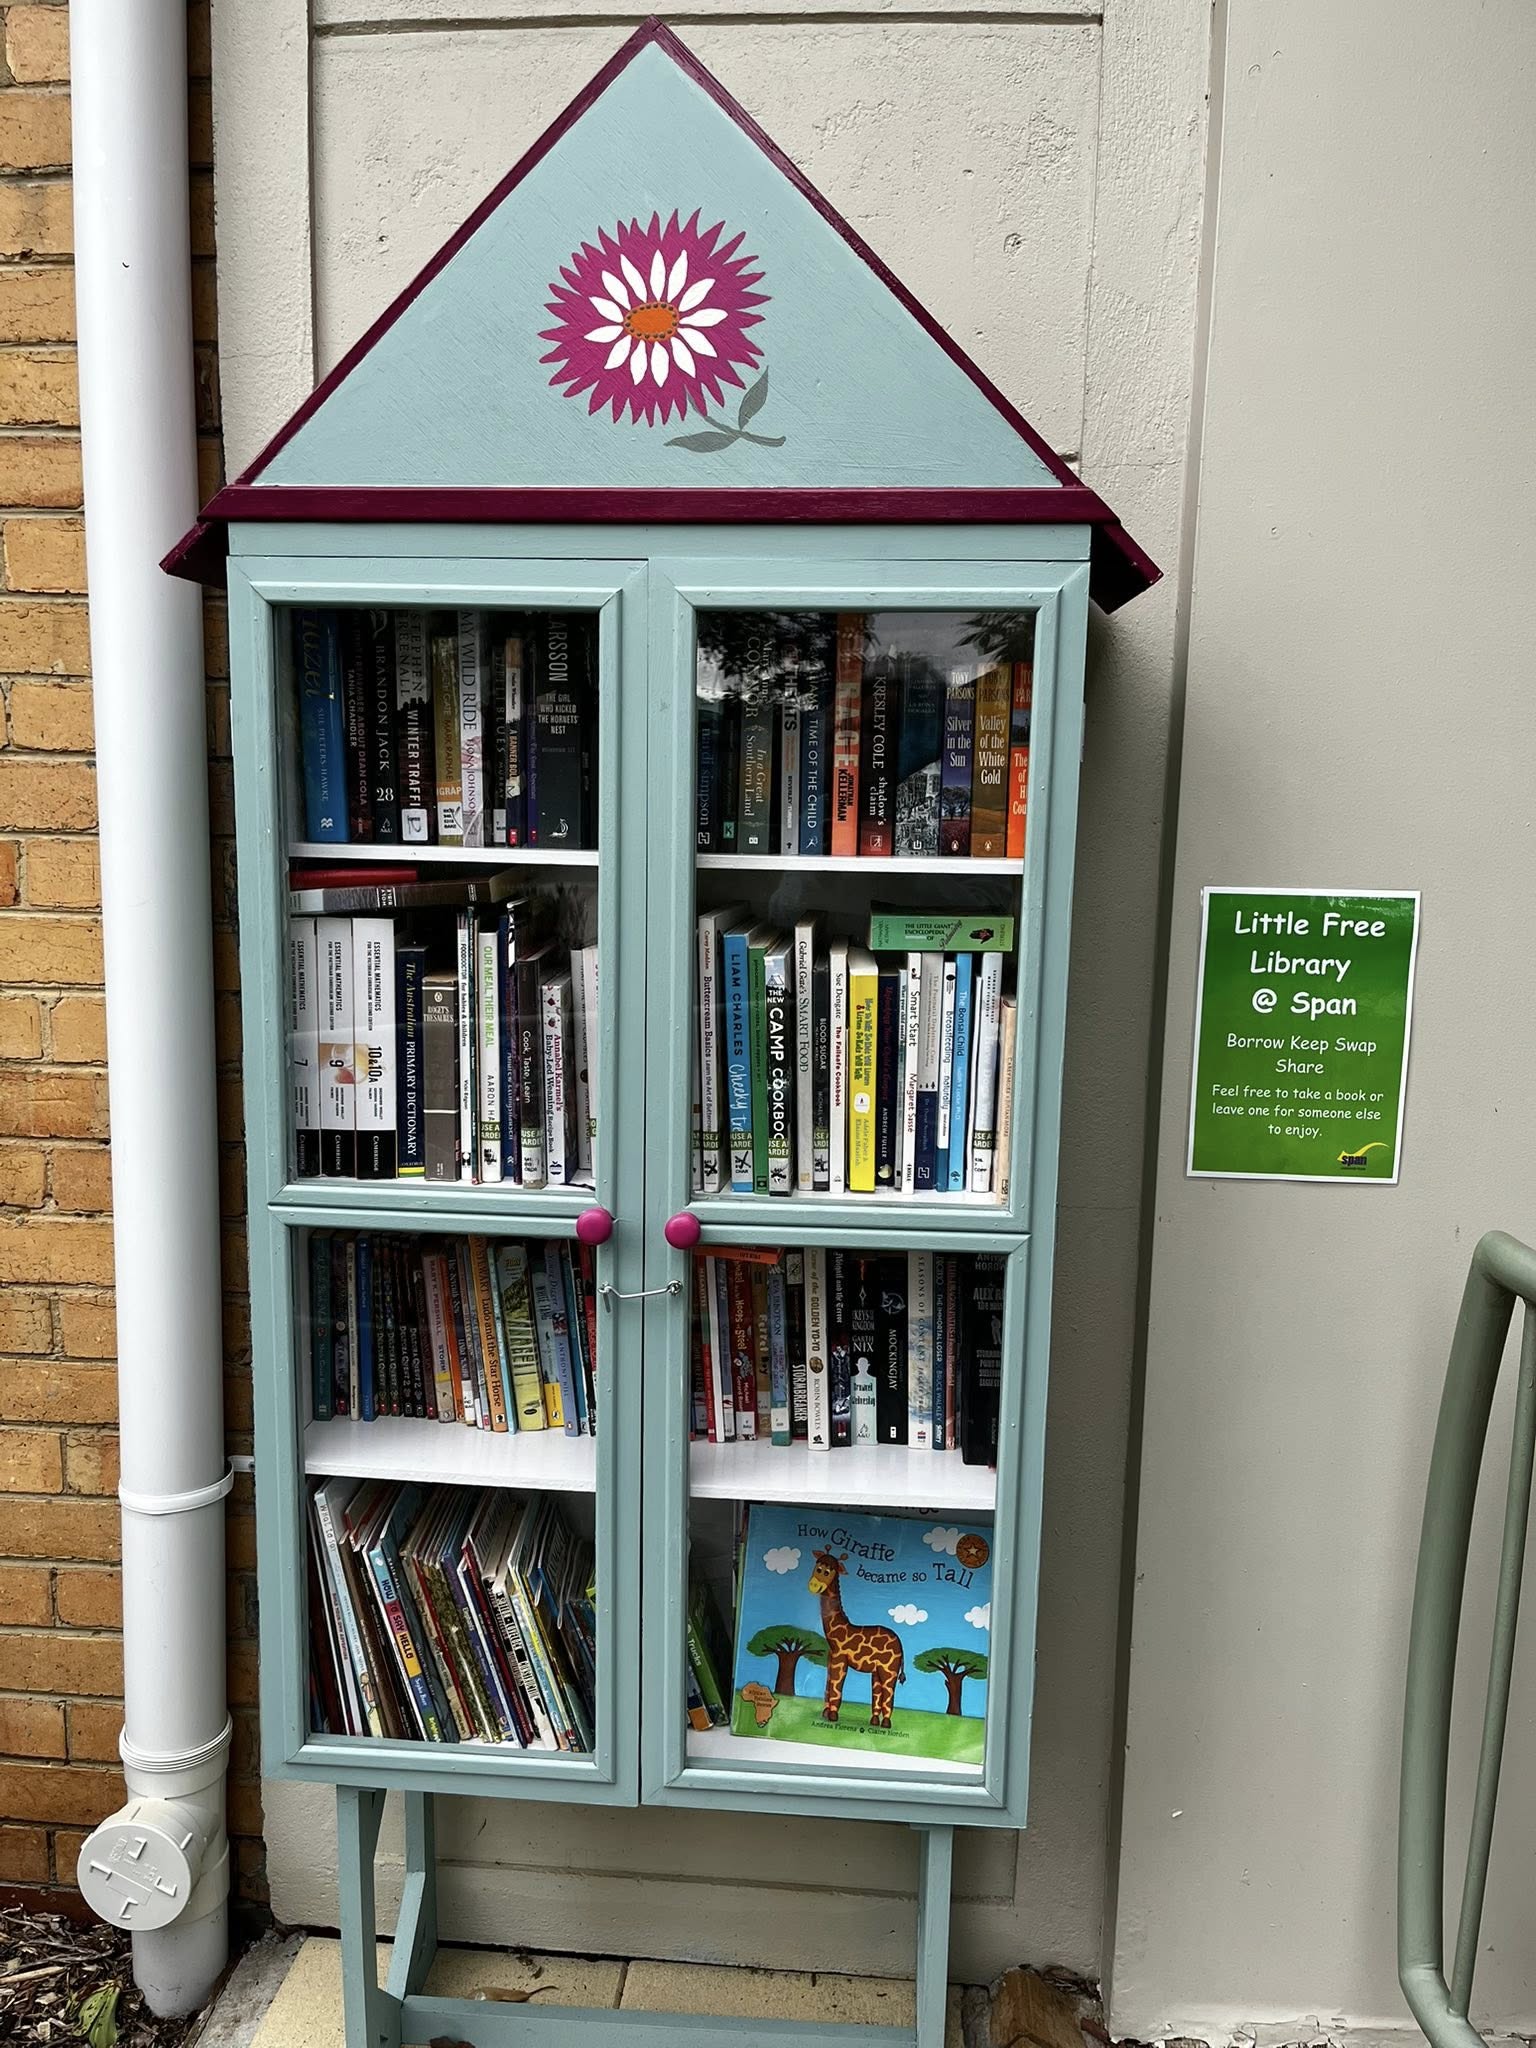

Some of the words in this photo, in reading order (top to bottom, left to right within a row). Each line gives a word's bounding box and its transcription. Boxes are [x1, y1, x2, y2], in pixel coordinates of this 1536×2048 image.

[461, 643, 476, 687] WILD
[375, 645, 389, 725] BRANDON
[462, 692, 477, 731] RIDE
[873, 676, 888, 732] KRESLEY
[348, 699, 358, 748] CHANDLER
[407, 710, 420, 758] WINTER
[808, 720, 820, 747] TIME
[832, 682, 863, 769] RAGE
[948, 715, 973, 732] Silver
[979, 715, 1007, 734] Valley
[376, 730, 390, 771] JACK
[465, 739, 475, 769] FIONA
[509, 735, 518, 766] BANNER
[871, 734, 885, 770] COLE
[957, 734, 972, 750] the
[991, 734, 1005, 749] the
[358, 751, 368, 777] DEAN
[745, 735, 757, 787] Southern
[807, 750, 819, 767] OF
[950, 751, 967, 767] Sun
[978, 751, 1006, 768] White
[755, 772, 767, 804] Great
[807, 770, 819, 791] THE
[980, 768, 1001, 785] Gold
[359, 780, 368, 806] COLA
[466, 770, 476, 816] JOHNSON
[744, 789, 756, 818] Land
[836, 769, 850, 823] KELLERMAN
[868, 786, 879, 817] claim
[806, 795, 818, 829] CHILD
[916, 923, 933, 931] LITTLE
[1234, 910, 1310, 935] Little
[1322, 911, 1387, 937] Free
[297, 940, 306, 970] ESSENTIAL
[373, 941, 381, 971] ESSENTIAL
[484, 945, 493, 965] OUR
[799, 941, 807, 970] Gabriel
[1250, 949, 1352, 983] Library
[406, 962, 417, 980] The
[731, 953, 741, 987] LIAM
[835, 973, 844, 986] Sue
[298, 971, 307, 1011] MATHEMATICS
[374, 972, 382, 1012] MATHEMATICS
[703, 975, 713, 1029] Buttercream
[833, 988, 844, 1019] Dengate
[909, 990, 920, 1020] Smart
[1252, 987, 1278, 1014] @
[1290, 991, 1357, 1021] Span
[406, 983, 418, 1038] Australian
[485, 995, 494, 1021] THEIR
[799, 997, 809, 1037] SMART
[486, 1022, 495, 1049] MEAL
[732, 992, 743, 1056] CHARLES
[770, 1007, 784, 1061] CAMP
[819, 1018, 827, 1043] BLOOD
[909, 1022, 920, 1048] Start
[942, 1009, 954, 1063] Breastfeeding
[522, 1031, 533, 1055] Cook,
[544, 1034, 555, 1075] Baby-Led
[553, 1034, 562, 1072] Annabel
[704, 1031, 714, 1058] Basics
[800, 1041, 810, 1072] FOOD
[819, 1044, 827, 1070] SUGAR
[956, 1035, 966, 1057] Child
[1226, 1032, 1285, 1051] Borrow
[1290, 1035, 1330, 1055] Keep
[1333, 1037, 1378, 1057] Swap
[329, 1058, 345, 1068] 9
[406, 1041, 417, 1089] PRIMARY
[522, 1056, 533, 1080] Taste,
[1275, 1058, 1325, 1075] Share
[487, 1074, 496, 1107] AARON
[523, 1081, 533, 1104] Learn
[546, 1076, 556, 1115] Weaning
[554, 1072, 564, 1112] Karmel's
[729, 1064, 749, 1110] Cheeky
[835, 1071, 843, 1107] Cookbook
[905, 1072, 918, 1112] Margaret
[940, 1074, 951, 1109] naturally
[1211, 1083, 1239, 1098] Feel
[1241, 1085, 1272, 1099] free
[1274, 1086, 1289, 1099] to
[1292, 1086, 1320, 1101] take
[1324, 1090, 1333, 1102] a
[1335, 1088, 1366, 1102] book
[1369, 1091, 1385, 1103] or
[407, 1091, 418, 1156] DICTIONARY
[881, 1107, 889, 1134] ANDREW
[1212, 1102, 1245, 1116] leave
[1248, 1105, 1270, 1117] one
[1273, 1104, 1294, 1118] for
[1297, 1107, 1352, 1120] someone
[1355, 1106, 1382, 1121] else
[1267, 1123, 1281, 1135] to
[1284, 1124, 1323, 1140] enjoy.
[1341, 1153, 1368, 1167] span
[479, 1253, 491, 1293] STEWART
[811, 1271, 820, 1280] of
[833, 1252, 844, 1278] Abigail
[772, 1279, 781, 1295] EVA
[836, 1279, 844, 1293] and
[936, 1293, 944, 1306] THE
[481, 1297, 491, 1321] Ludo
[734, 1299, 745, 1323] Hoops
[811, 1296, 820, 1328] GOLDEN
[918, 1301, 925, 1315] OF
[484, 1321, 495, 1342] and
[759, 1314, 769, 1352] Ferret
[936, 1307, 944, 1342] IMMORTAL
[487, 1342, 498, 1358] the
[735, 1329, 748, 1350] Steel
[812, 1329, 821, 1352] YO-YO
[853, 1342, 875, 1352] NIX
[936, 1342, 944, 1362] LOSER
[490, 1359, 501, 1379] Star
[559, 1342, 567, 1379] ANTHONY
[888, 1328, 898, 1392] MOCKINGJAY
[403, 1379, 412, 1387] 2
[414, 1381, 422, 1389] 2
[493, 1380, 504, 1408] Horse
[792, 1363, 807, 1423] STORMBREAKER
[936, 1370, 944, 1391] BRUCE
[936, 1392, 944, 1421] WALKLEY
[797, 1523, 829, 1540] How
[830, 1527, 897, 1563] Giraffe
[382, 1579, 396, 1601] HOW
[856, 1563, 908, 1585] became
[913, 1570, 928, 1583] so
[932, 1562, 976, 1590] Tall
[392, 1613, 408, 1634] SAY
[398, 1632, 415, 1660] HELLO
[687, 1639, 702, 1668] Trucks
[811, 1720, 833, 1730] Andrea
